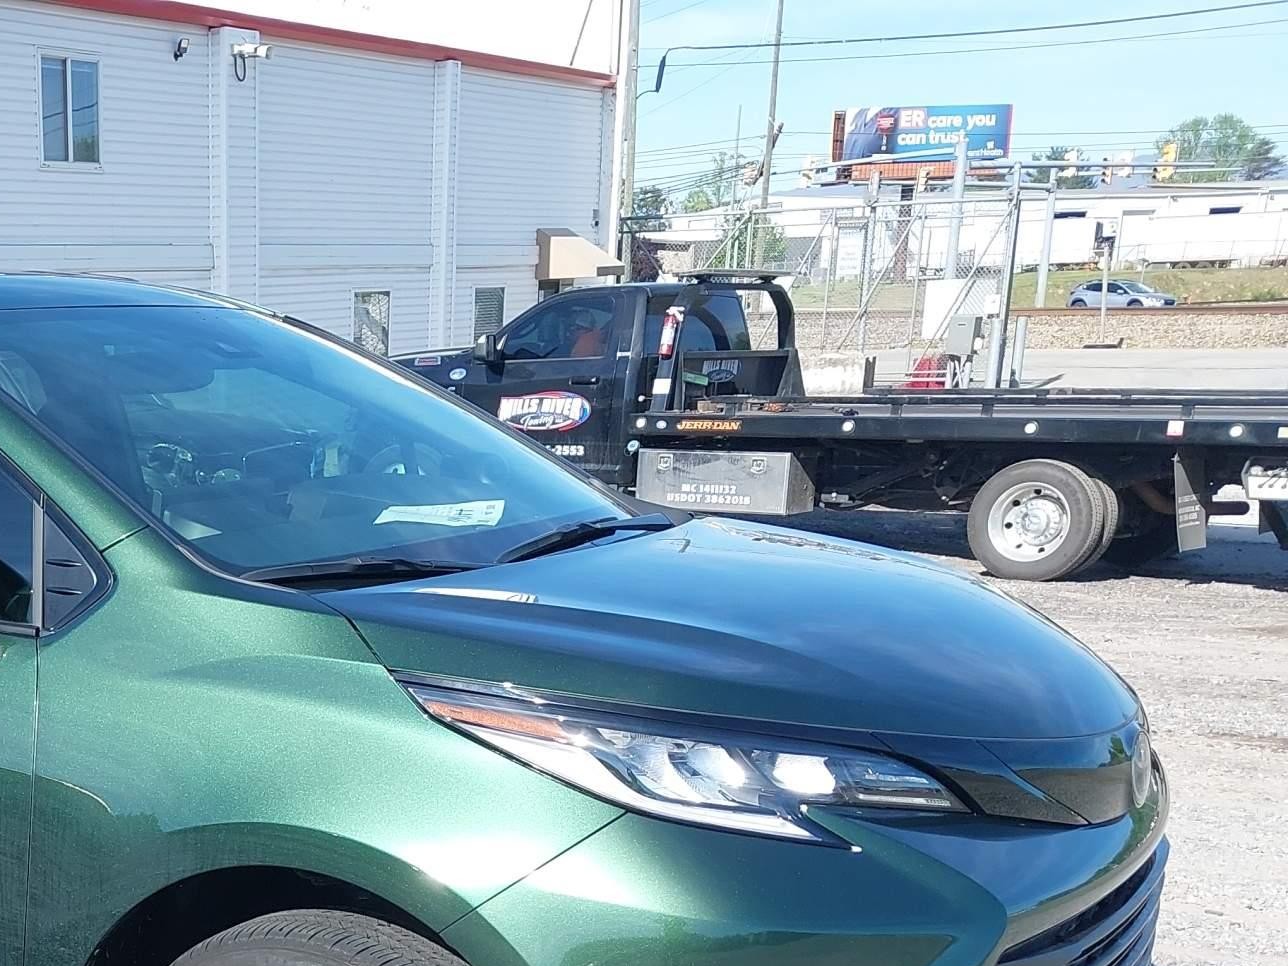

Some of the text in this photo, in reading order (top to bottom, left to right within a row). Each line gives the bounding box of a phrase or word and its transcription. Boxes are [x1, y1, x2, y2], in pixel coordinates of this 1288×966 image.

[900, 110, 924, 128] ER
[928, 115, 963, 128] care
[967, 114, 997, 131] you
[897, 133, 926, 145] can
[498, 398, 583, 421] MILLS RIVER
[520, 414, 554, 431] Towing
[681, 484, 737, 495] MC 1411132
[666, 493, 703, 503] USDOT
